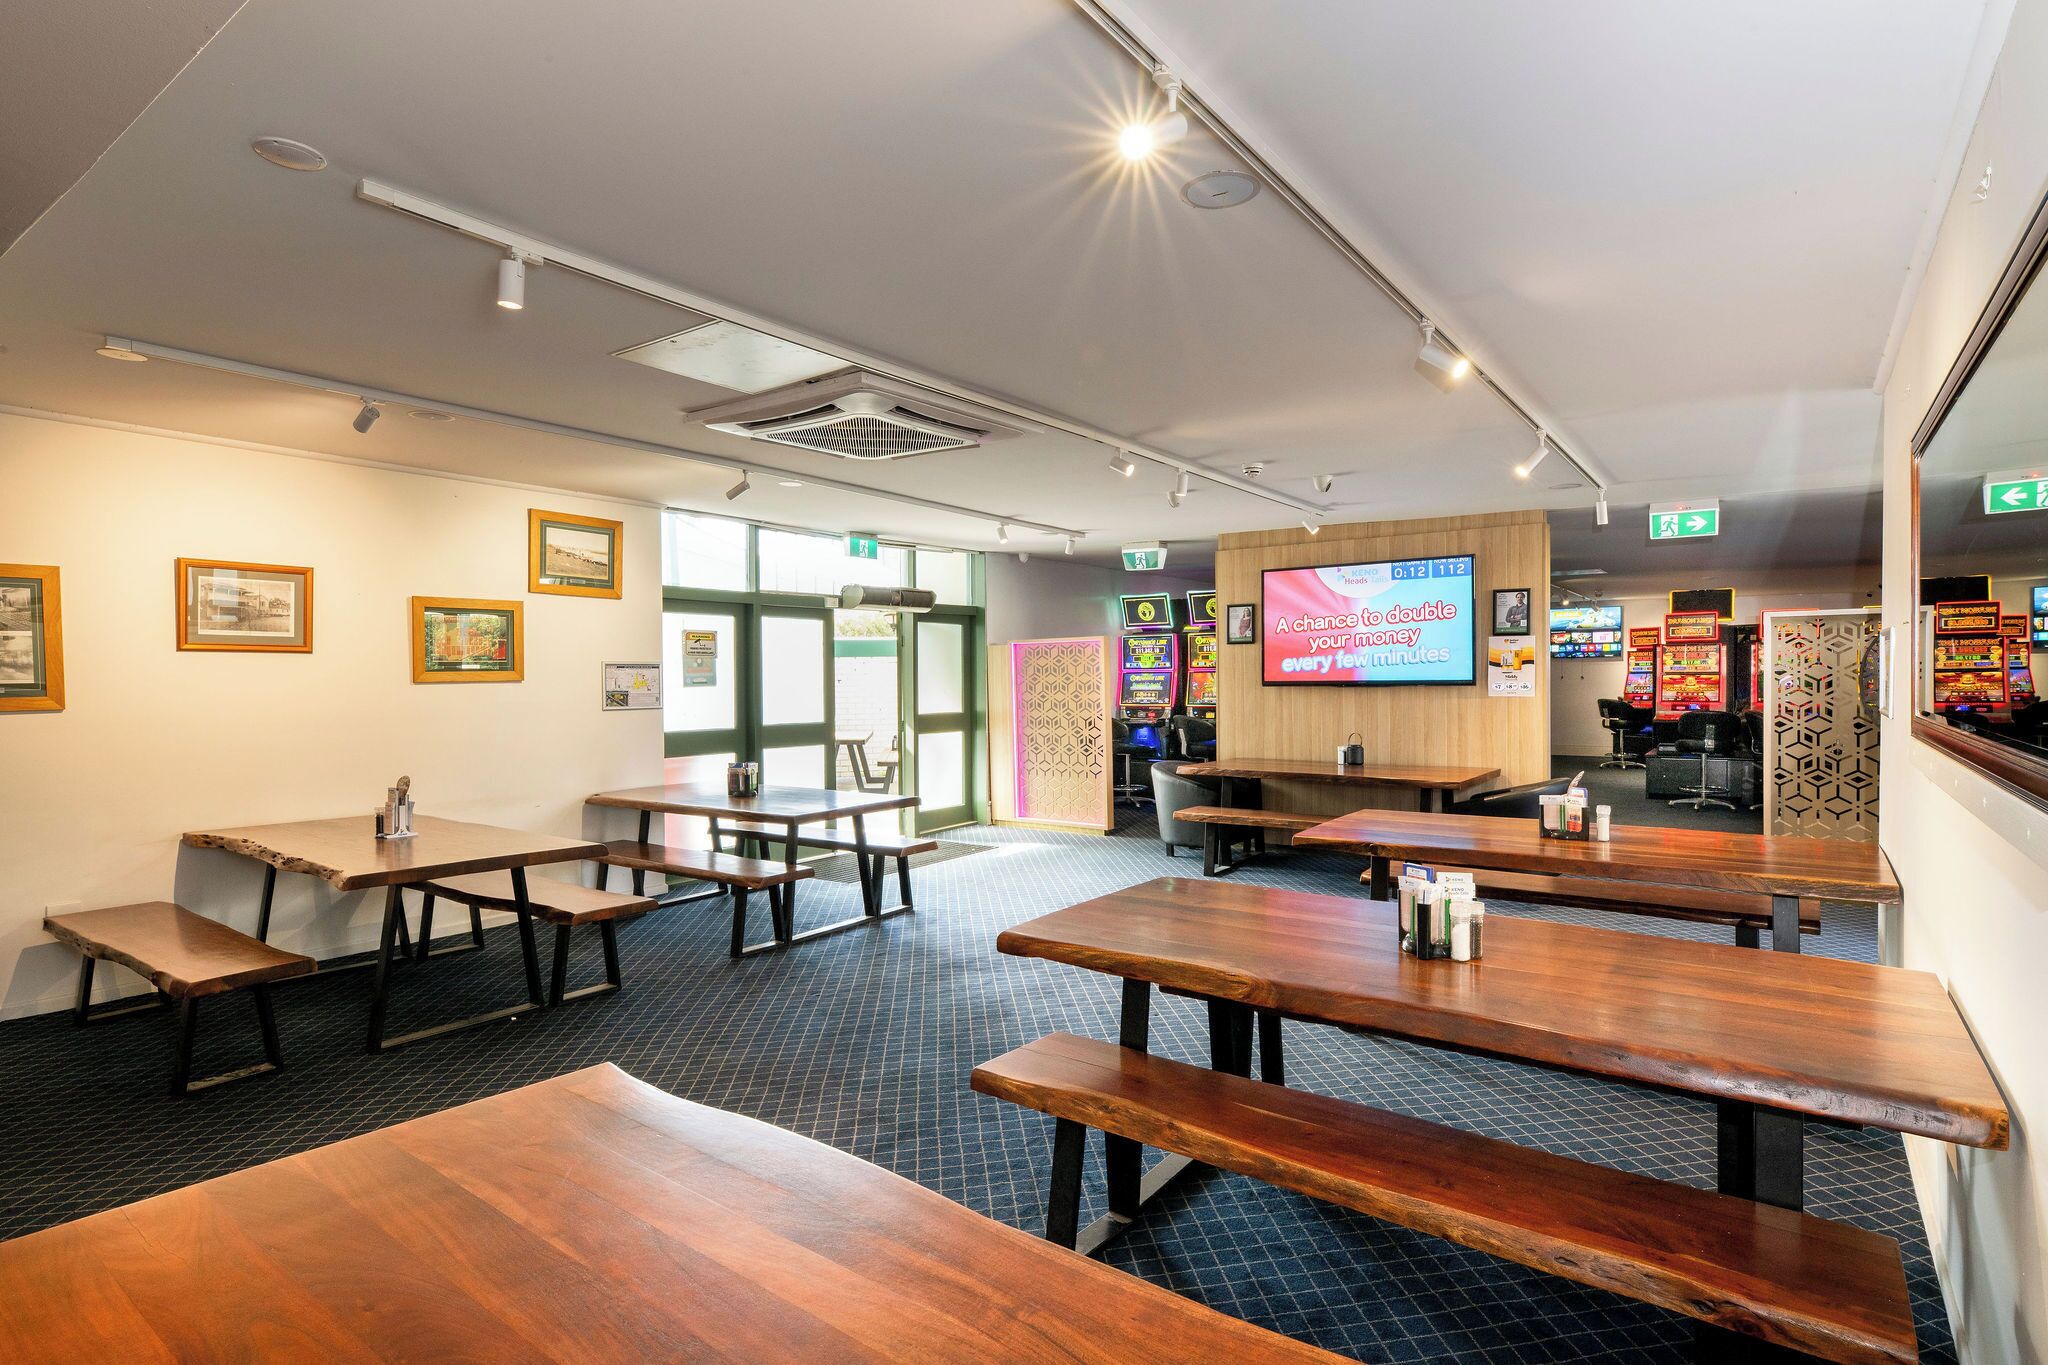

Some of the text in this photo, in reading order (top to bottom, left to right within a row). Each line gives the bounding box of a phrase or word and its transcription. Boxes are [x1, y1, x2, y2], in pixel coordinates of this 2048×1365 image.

[1351, 568, 1378, 577] KENO
[1394, 566, 1425, 578] 0:12
[1440, 564, 1464, 575] 112
[1344, 577, 1368, 585] Heads
[1276, 600, 1457, 634] A chance to double
[1309, 628, 1421, 653] your money
[1282, 645, 1450, 674] every few minutes
